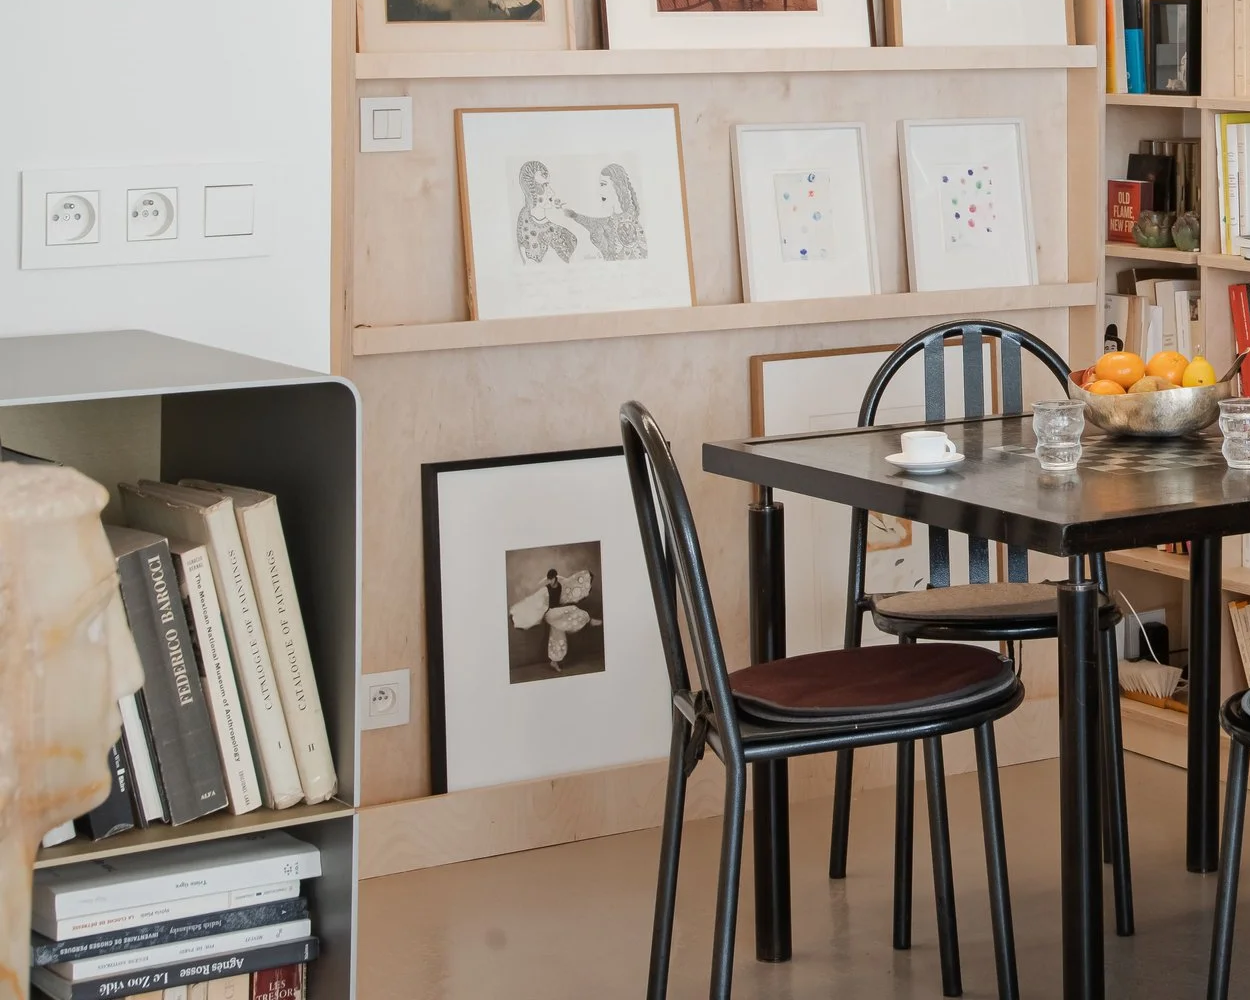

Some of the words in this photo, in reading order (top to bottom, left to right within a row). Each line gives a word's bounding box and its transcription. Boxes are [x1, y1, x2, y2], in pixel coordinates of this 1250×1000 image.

[1118, 191, 1131, 204] OLD
[1113, 205, 1135, 220] FLAME,
[1110, 219, 1124, 232] NEW
[195, 573, 203, 588] The
[228, 549, 248, 615] PAINTINGS
[266, 549, 285, 615] PAINTINGS
[148, 554, 174, 624] BAROCCI
[199, 590, 210, 625] Mexican
[245, 619, 254, 636] OF
[279, 618, 291, 635] OF
[206, 625, 218, 661] National
[166, 628, 193, 706] FEDERICO
[215, 662, 226, 697] Museum
[249, 639, 273, 711] CATALOGUE
[285, 639, 307, 712] CATALOGUE
[223, 698, 230, 707] of
[225, 708, 241, 762] Anthropology
[200, 789, 216, 800] ALFA
[169, 922, 202, 935] Schalansky
[201, 919, 222, 930] Judith
[89, 940, 112, 950] CHOSES
[123, 931, 159, 944] INVENTAIRE
[59, 944, 89, 956] PERDUES
[179, 965, 210, 979] Rosse
[211, 957, 245, 975] Agnès
[127, 975, 150, 990] Zoo
[152, 971, 168, 985] Le
[269, 980, 286, 991] LES
[99, 980, 125, 996] vidé
